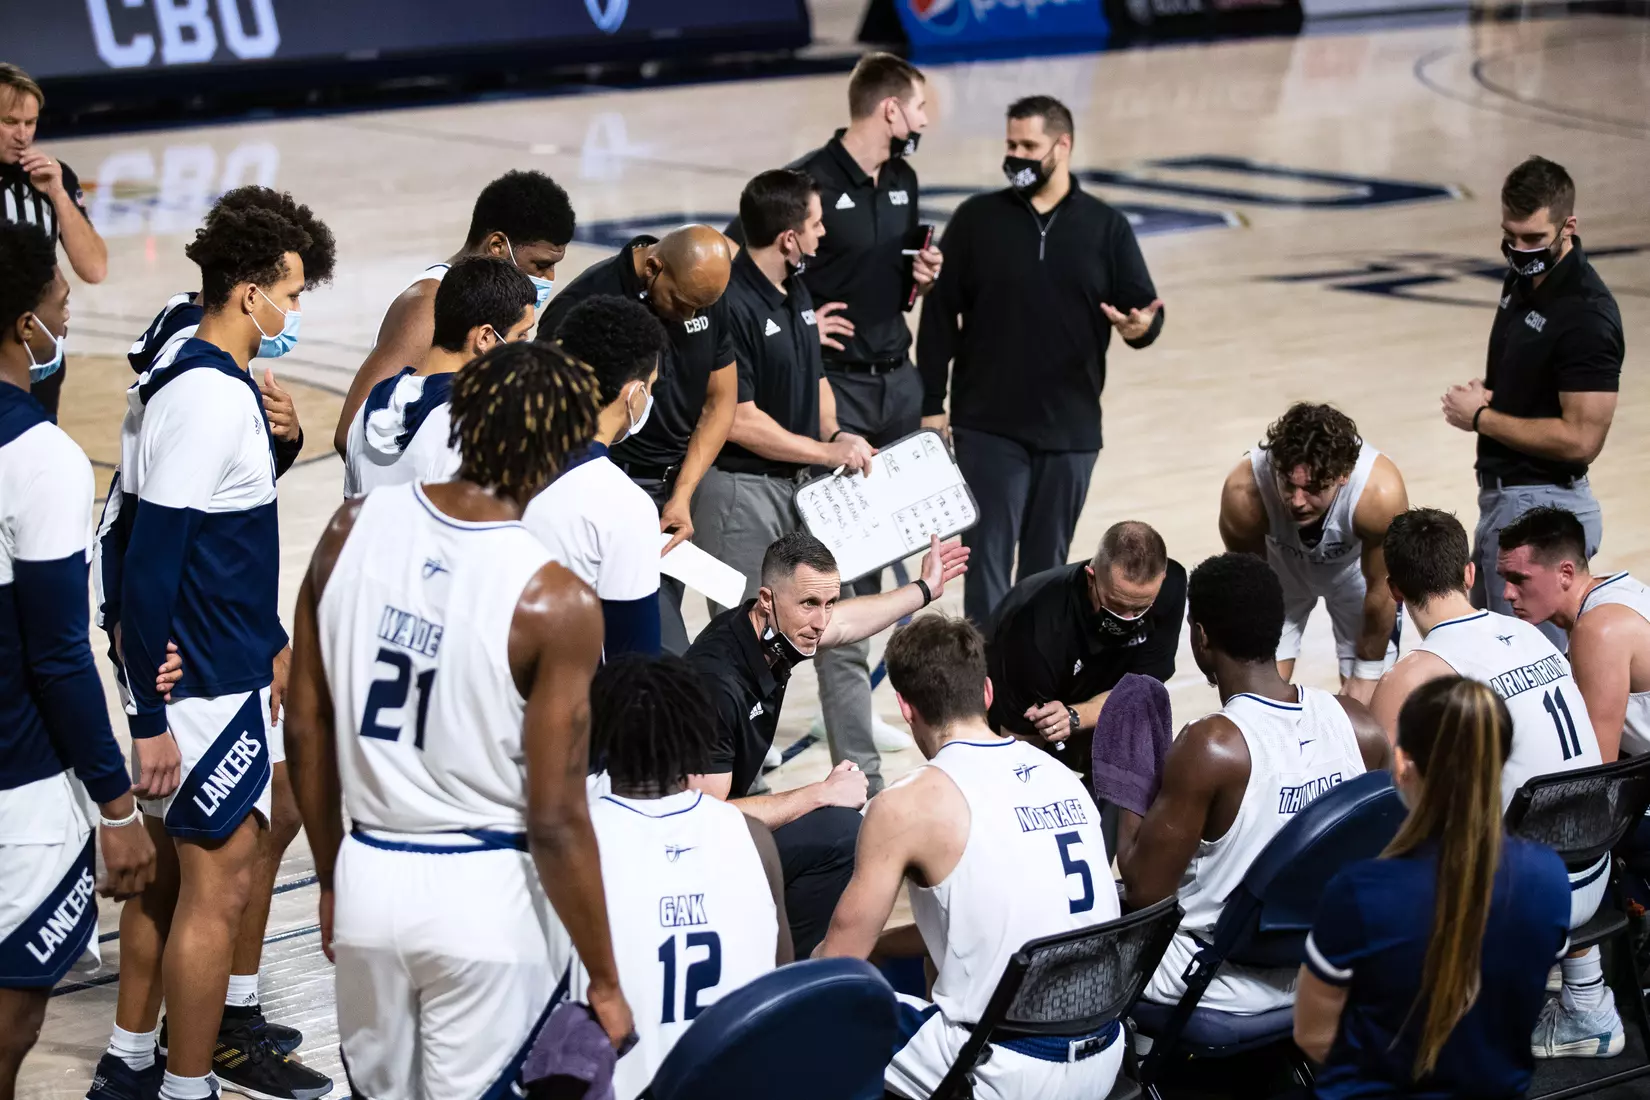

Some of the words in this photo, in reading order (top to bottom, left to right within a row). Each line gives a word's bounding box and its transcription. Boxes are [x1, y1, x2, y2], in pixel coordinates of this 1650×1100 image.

[377, 605, 445, 658] WADE
[360, 646, 439, 752] 21
[1542, 685, 1583, 762] 11
[192, 729, 262, 818] LANCERS
[1014, 798, 1089, 833] NOTTAGE
[659, 893, 708, 928] GAK
[1054, 830, 1096, 915] 5
[25, 865, 97, 966] LANCERS
[658, 931, 723, 1024] 12
